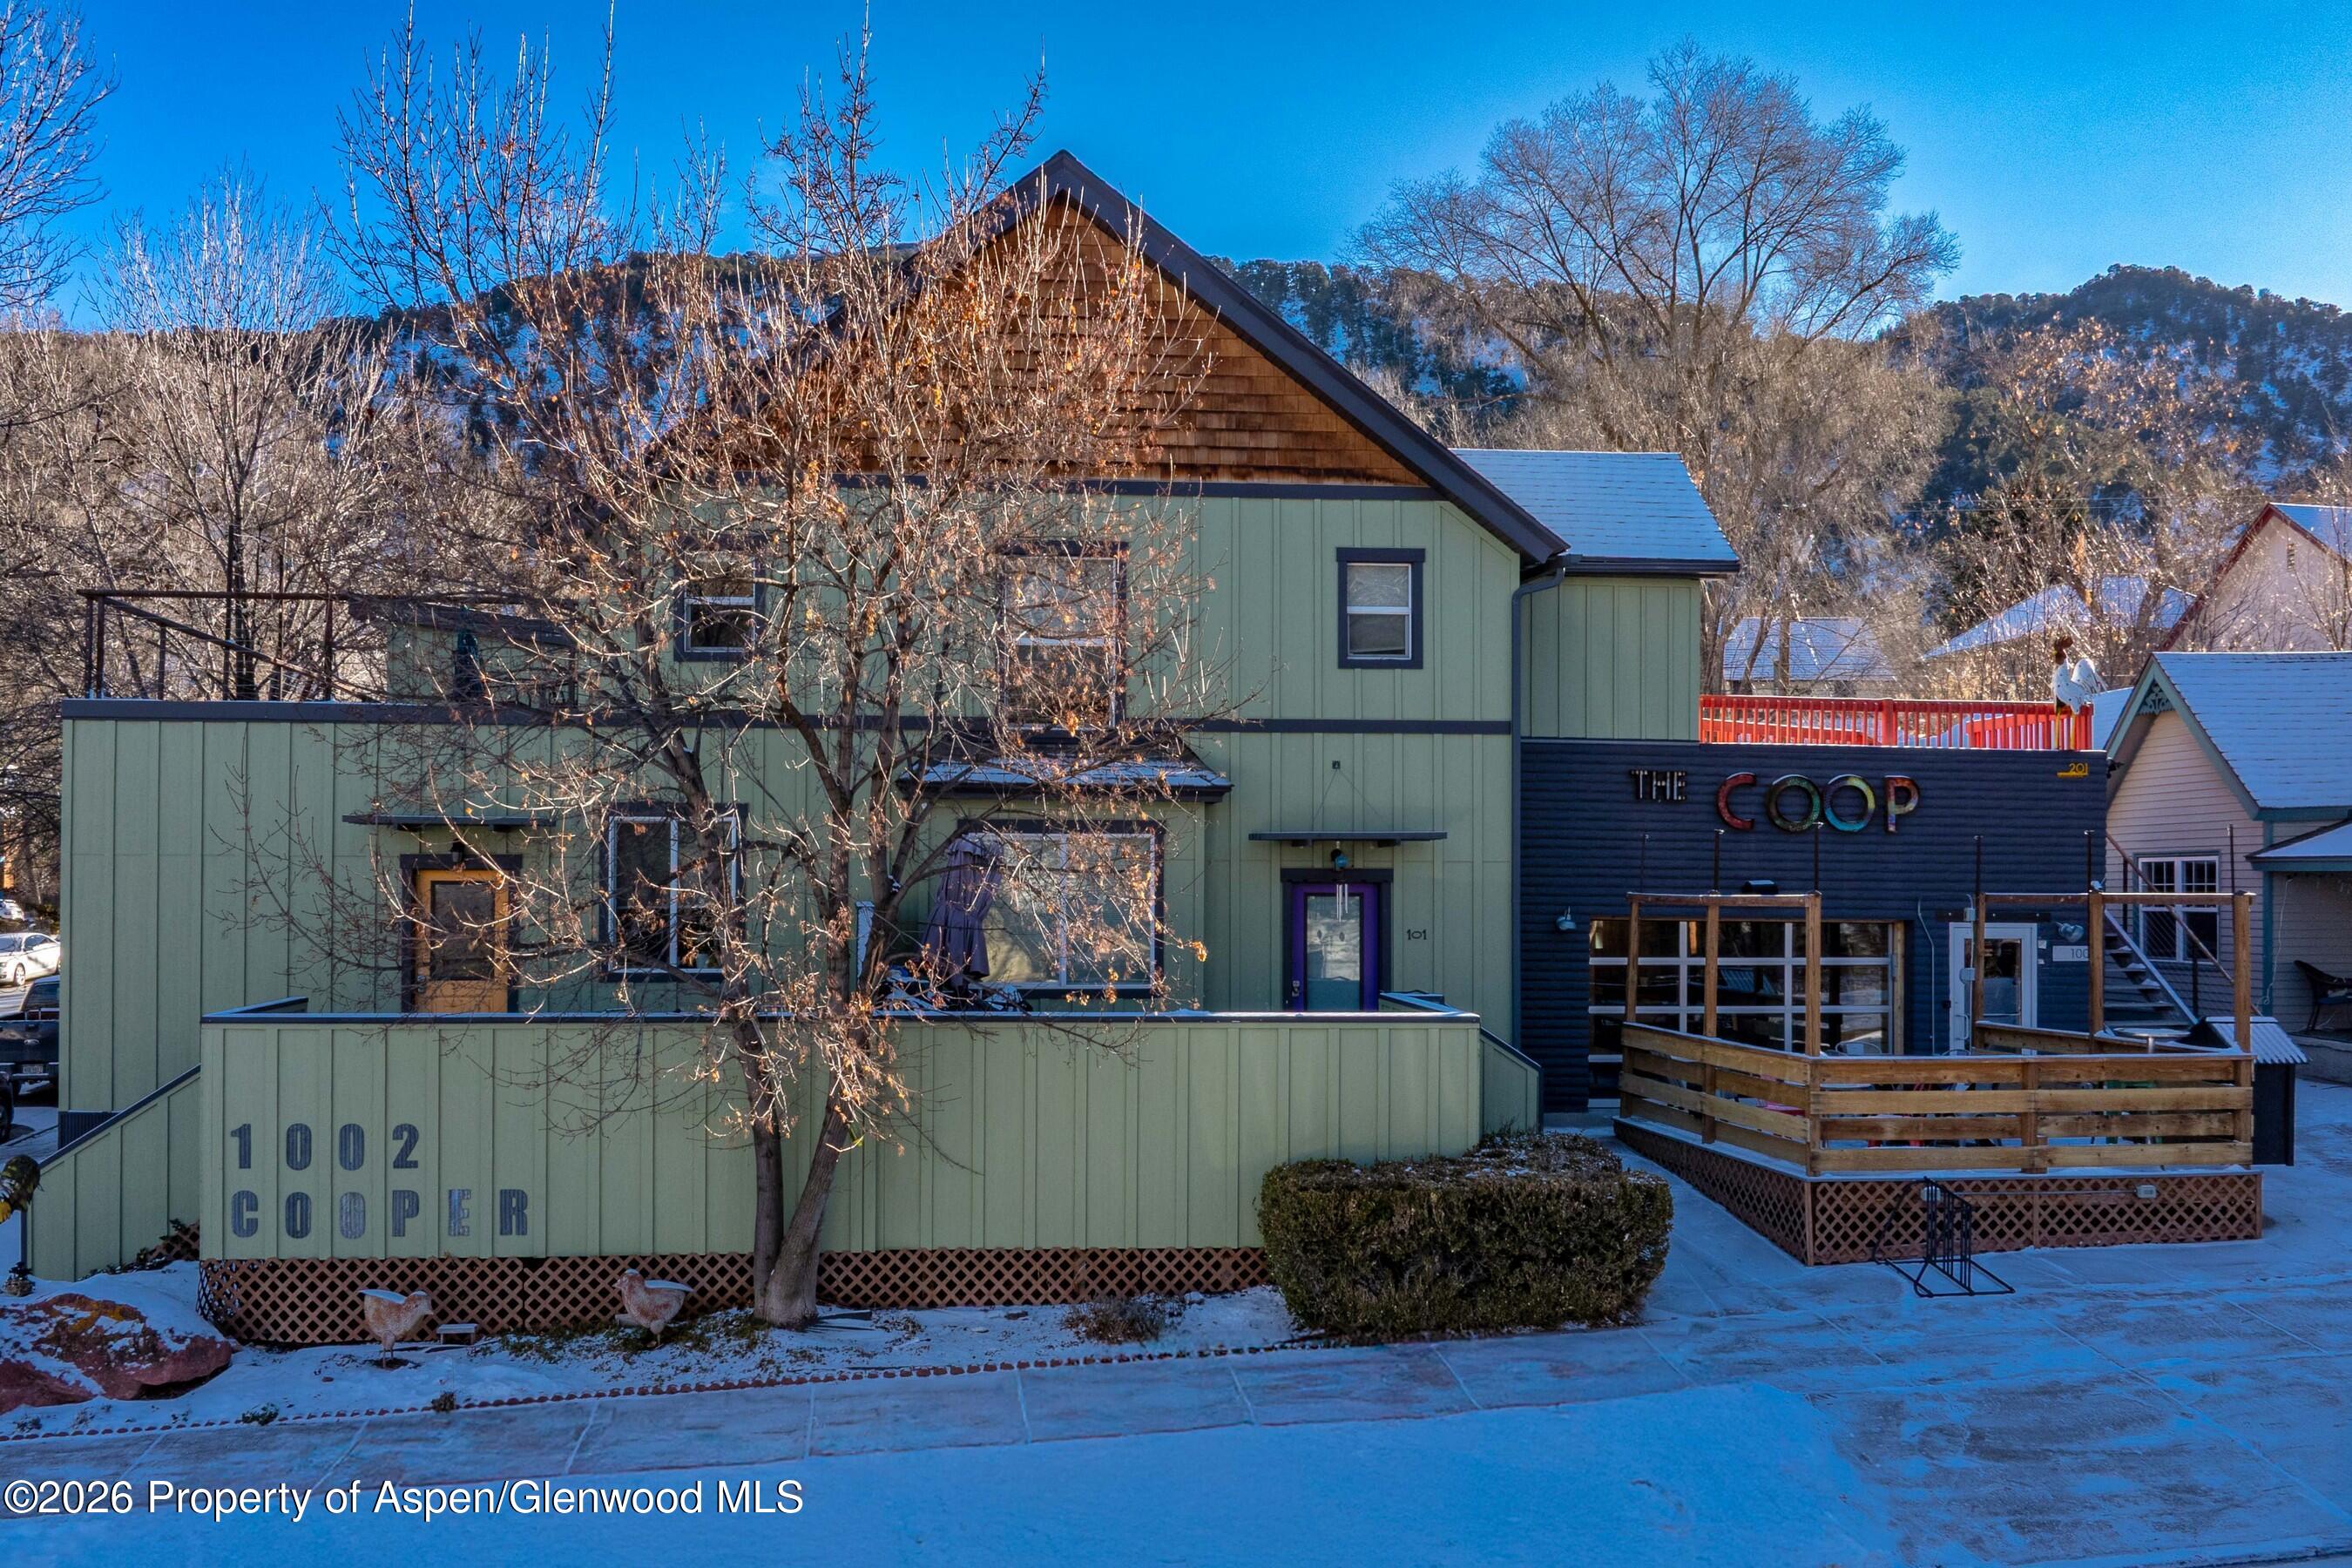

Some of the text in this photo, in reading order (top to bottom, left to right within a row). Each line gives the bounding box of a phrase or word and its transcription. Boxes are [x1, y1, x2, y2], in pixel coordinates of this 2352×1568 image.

[2069, 762, 2089, 776] 201
[1631, 770, 1920, 834] THE COOP
[1406, 929, 1428, 941] 101
[230, 1123, 420, 1171] 1002
[230, 1189, 528, 1240] COOPER
